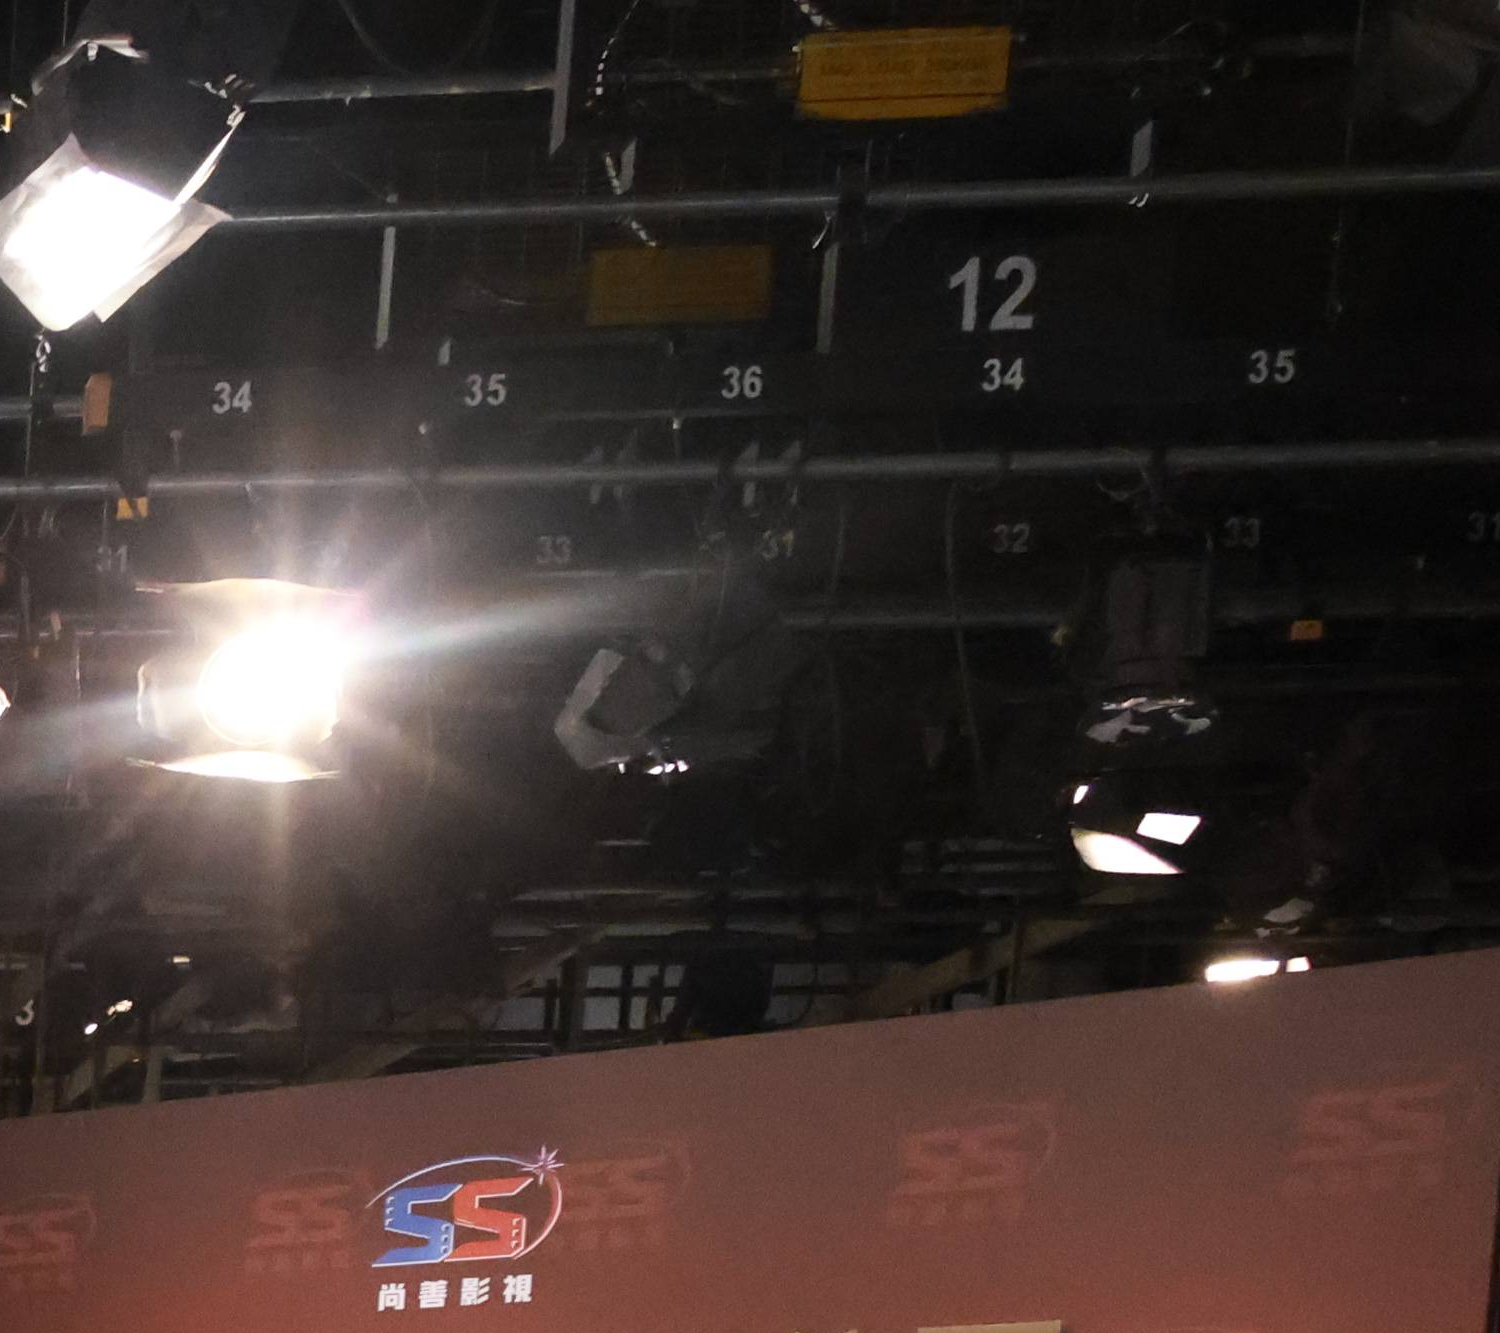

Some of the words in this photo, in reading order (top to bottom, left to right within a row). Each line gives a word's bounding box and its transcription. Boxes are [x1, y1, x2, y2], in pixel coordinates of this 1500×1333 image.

[948, 255, 1037, 332] 12
[721, 365, 763, 399] 36
[981, 357, 1025, 392] 34
[1248, 349, 1295, 384] 35
[212, 381, 253, 415] 34
[463, 373, 507, 407] 35
[371, 1176, 534, 1267] SS
[377, 1274, 533, 1311] 尚善影視
